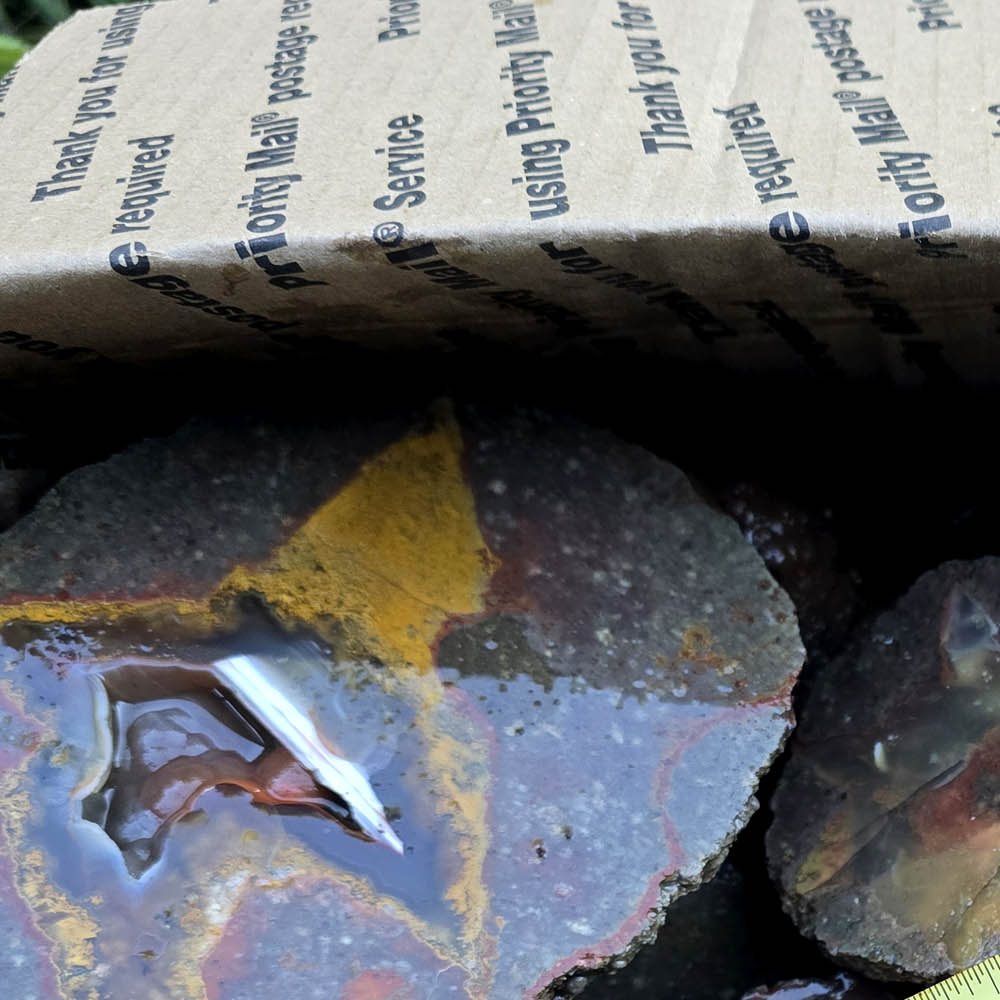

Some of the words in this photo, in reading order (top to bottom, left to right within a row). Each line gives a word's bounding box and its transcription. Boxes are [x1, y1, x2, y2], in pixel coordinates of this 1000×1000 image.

[612, 1, 657, 30] for
[805, 8, 883, 84] postage
[78, 56, 128, 83] for
[264, 25, 319, 105] postage
[500, 50, 553, 137] Priority
[628, 36, 680, 75] you
[72, 85, 118, 126] you
[245, 112, 301, 172] Mail®
[628, 81, 693, 155] Thank
[832, 90, 909, 146] Mail®
[31, 126, 103, 203] Thank
[112, 134, 175, 234] required
[374, 113, 426, 209] Service
[512, 139, 571, 221] using
[712, 102, 798, 205] required
